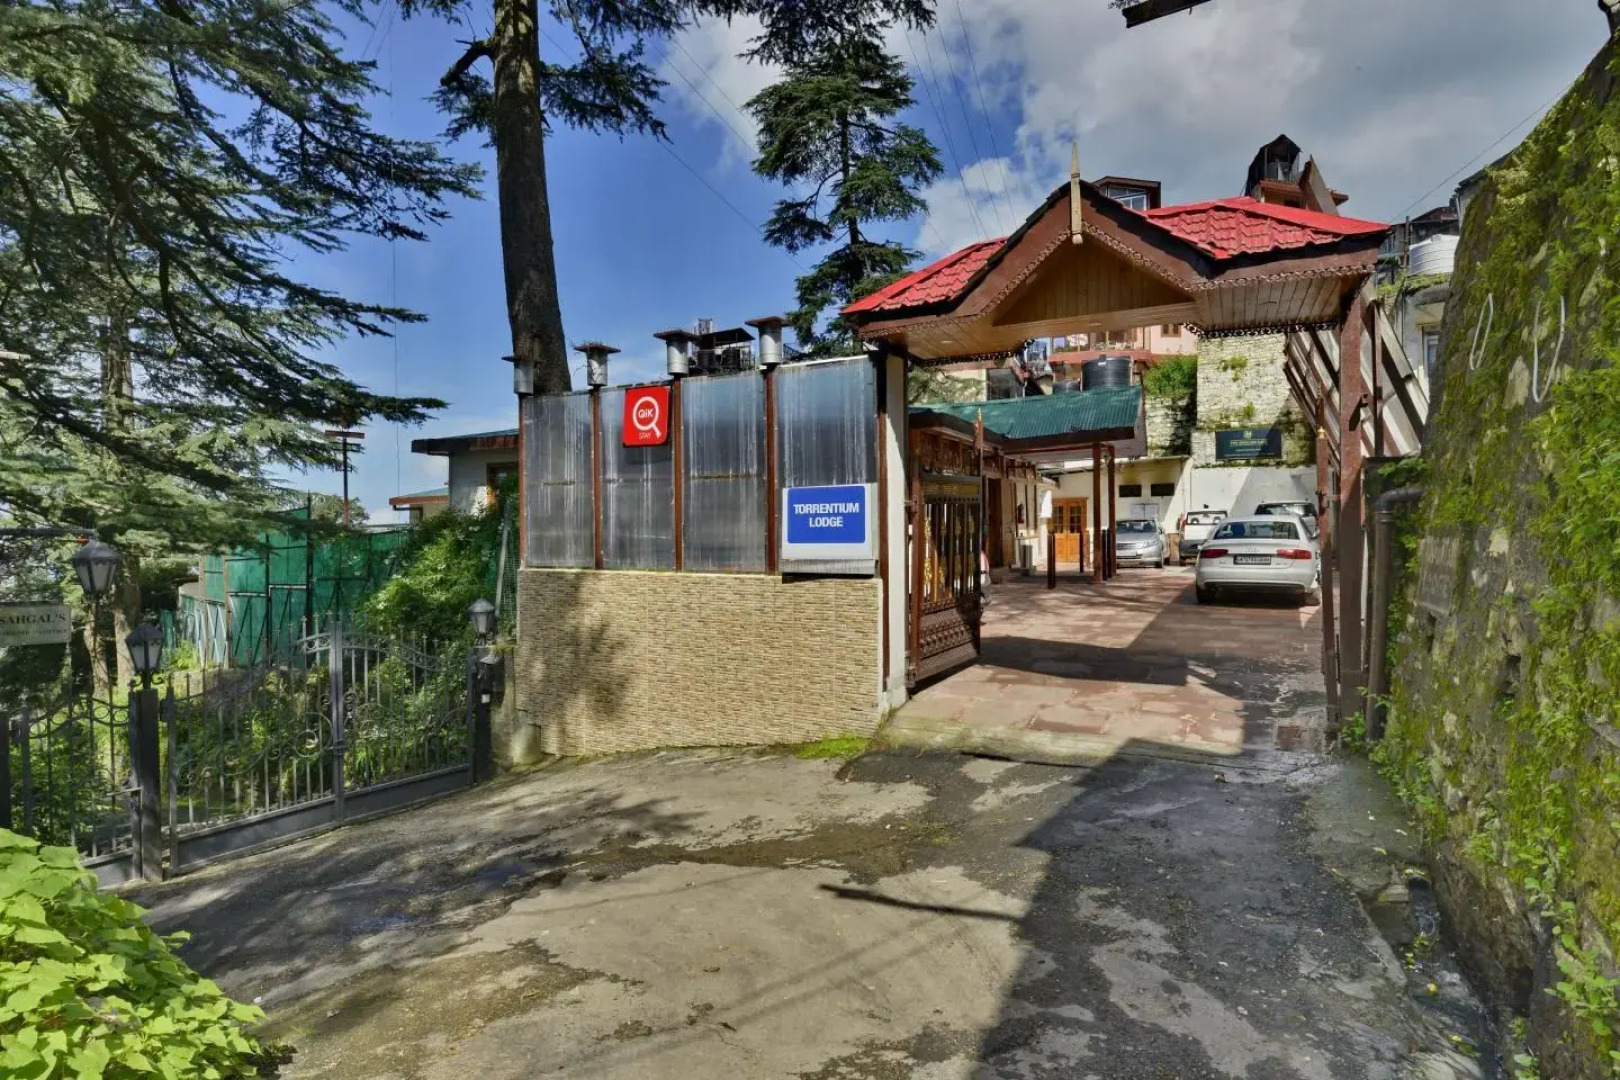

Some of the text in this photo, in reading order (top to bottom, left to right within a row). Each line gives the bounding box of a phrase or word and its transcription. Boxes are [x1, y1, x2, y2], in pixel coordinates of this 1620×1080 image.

[638, 431, 652, 440] STAY
[793, 503, 860, 514] TORRENTIUM
[809, 516, 844, 528] LODGE
